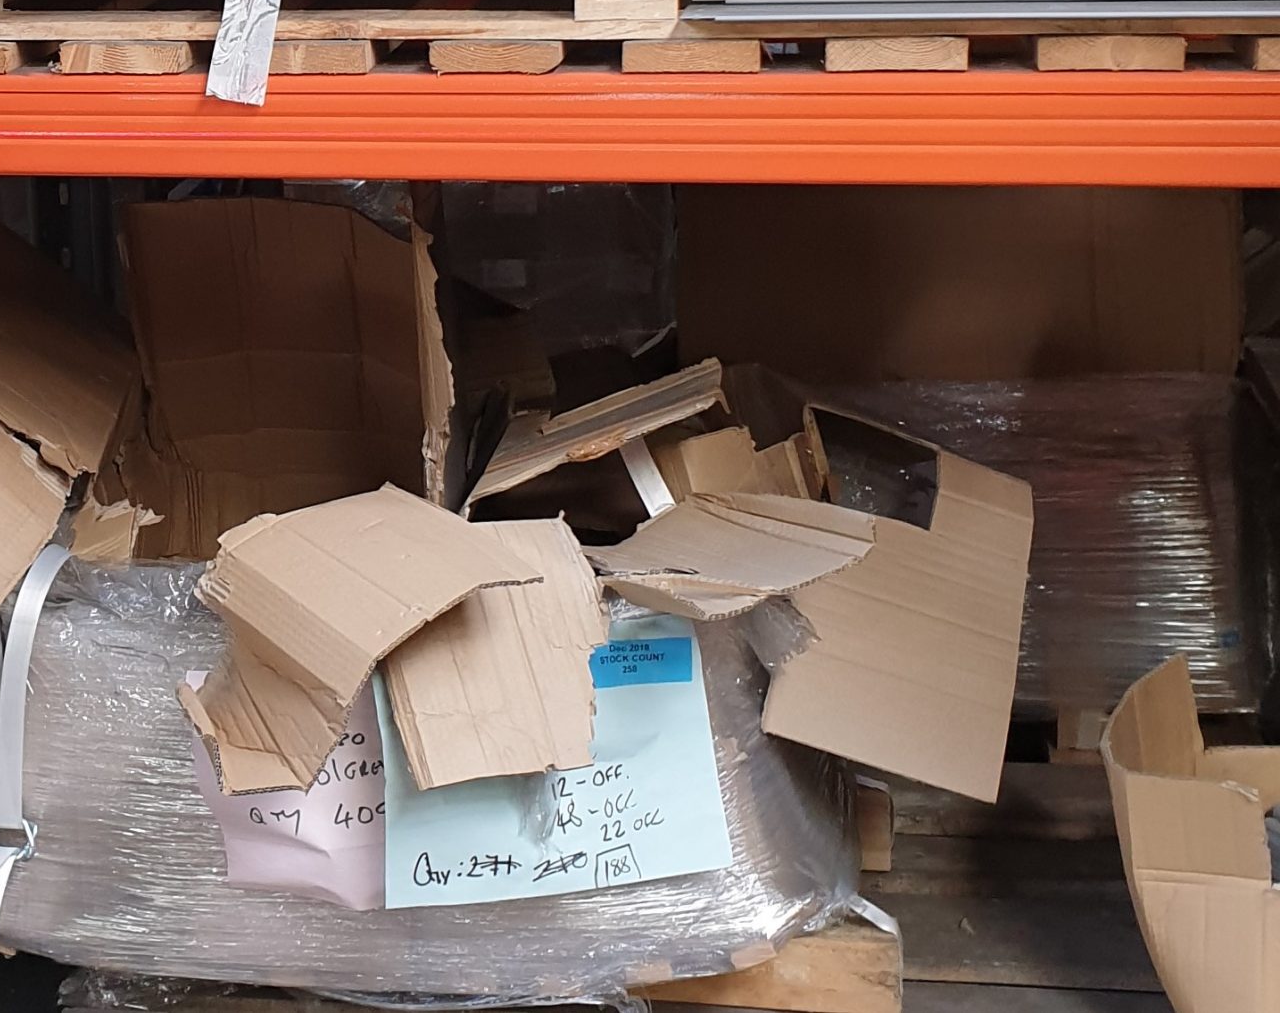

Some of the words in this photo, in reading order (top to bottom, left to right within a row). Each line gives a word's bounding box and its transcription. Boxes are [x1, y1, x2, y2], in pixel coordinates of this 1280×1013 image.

[608, 644, 627, 653] Dec
[599, 655, 629, 665] STOCK
[631, 652, 666, 663] COUNT
